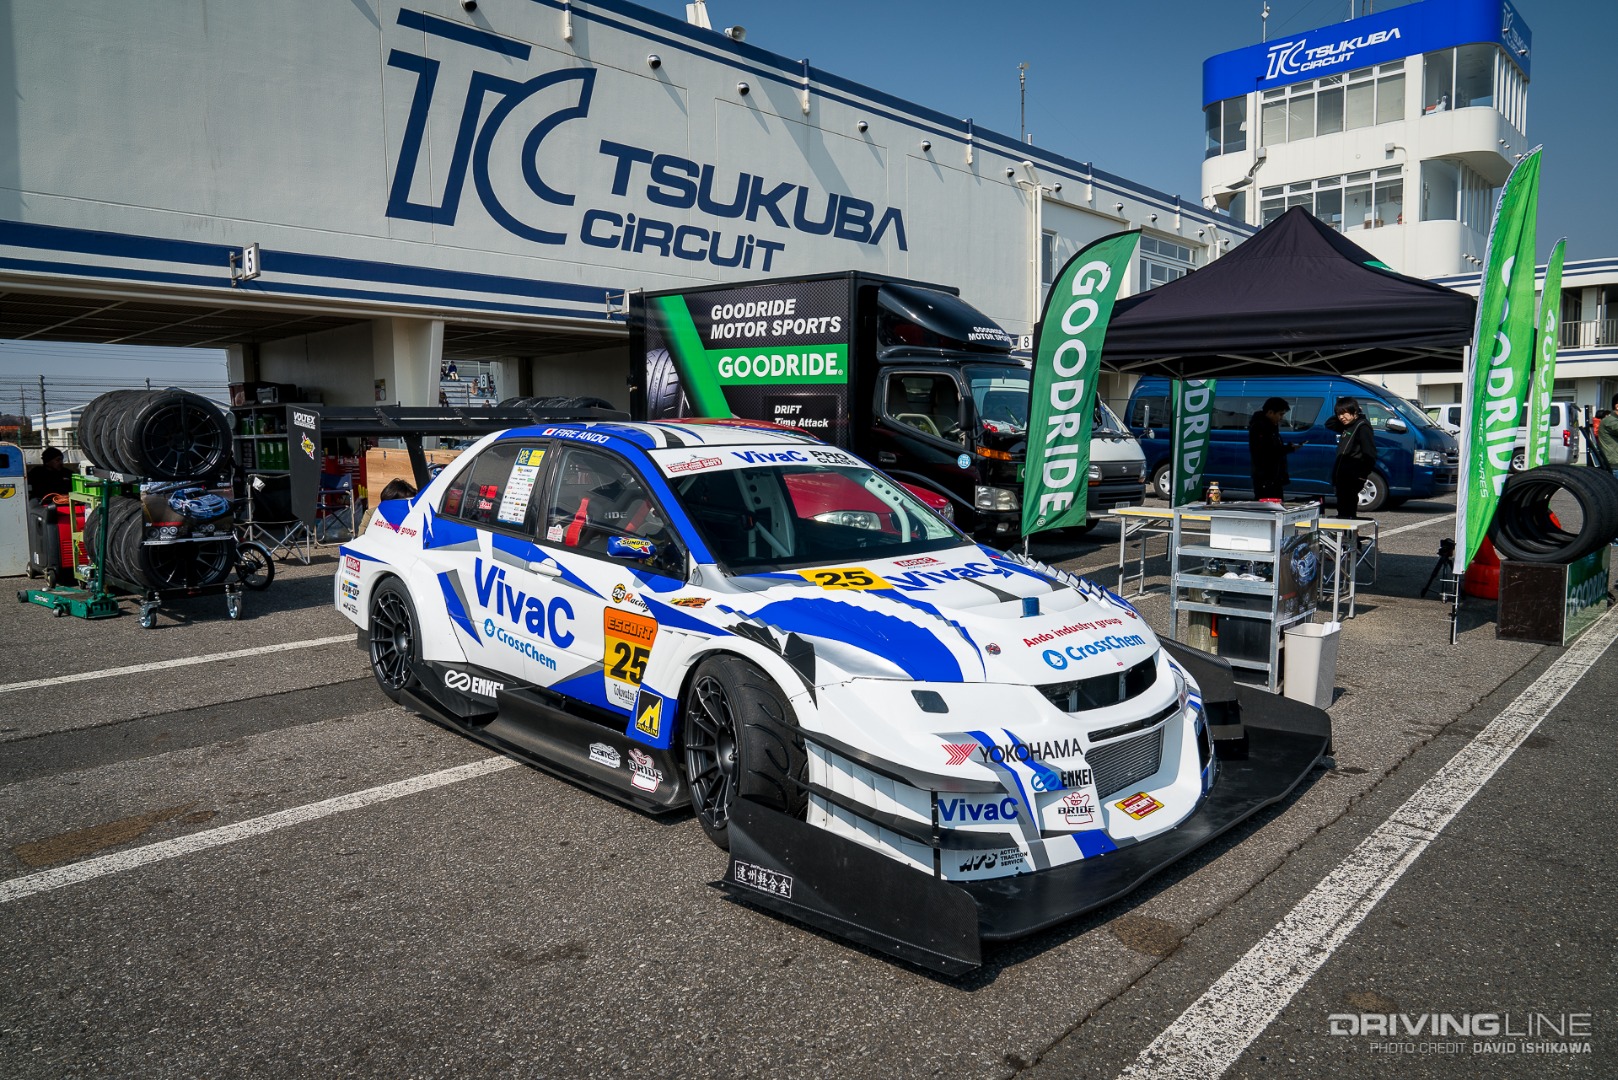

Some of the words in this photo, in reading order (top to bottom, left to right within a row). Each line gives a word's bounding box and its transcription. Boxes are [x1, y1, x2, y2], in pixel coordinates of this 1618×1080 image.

[1304, 27, 1401, 61] TSUKUBA
[599, 139, 908, 251] TSUKUBA
[247, 251, 255, 273] 5
[710, 298, 797, 321] GOODRIDE
[710, 321, 768, 340] MOTOR
[771, 316, 842, 337] SPORTS
[968, 333, 996, 341] MOTOR
[1023, 336, 1030, 348] 8
[717, 352, 840, 379] GOODRIDE
[1038, 259, 1112, 517] GOODRIDE
[293, 411, 316, 425] VOLTEX
[774, 404, 802, 415] DRIFT
[772, 417, 797, 428] Time
[797, 417, 829, 429] Attack
[554, 428, 578, 438] FIRE
[576, 431, 611, 444] ANDO
[730, 450, 808, 464] VivaC
[808, 450, 850, 460] PRO
[818, 457, 858, 466] CLASS
[621, 539, 651, 547] SUNOCO
[814, 571, 875, 588] 25
[883, 562, 1003, 592] VivaC
[474, 557, 576, 649] VivaC
[612, 588, 625, 600] 25
[624, 592, 650, 613] Racing
[607, 616, 654, 641] ESCORT
[1022, 633, 1055, 648] Ando
[1051, 621, 1098, 638] industry
[1094, 617, 1123, 629] group
[496, 627, 557, 672] CrossChem
[1065, 634, 1146, 661] CrossChem
[610, 641, 650, 685] 25
[636, 722, 659, 737] ANSIN
[978, 738, 1084, 764] YOKOHAMA
[628, 759, 663, 781] BRIDE
[1060, 768, 1093, 788] ENKEI
[938, 797, 1019, 822] VivaC
[1057, 805, 1095, 815] BRIDE
[1000, 847, 1020, 856] ACTIVE
[1000, 851, 1029, 862] TRACTION
[1000, 858, 1024, 867] SERVICE
